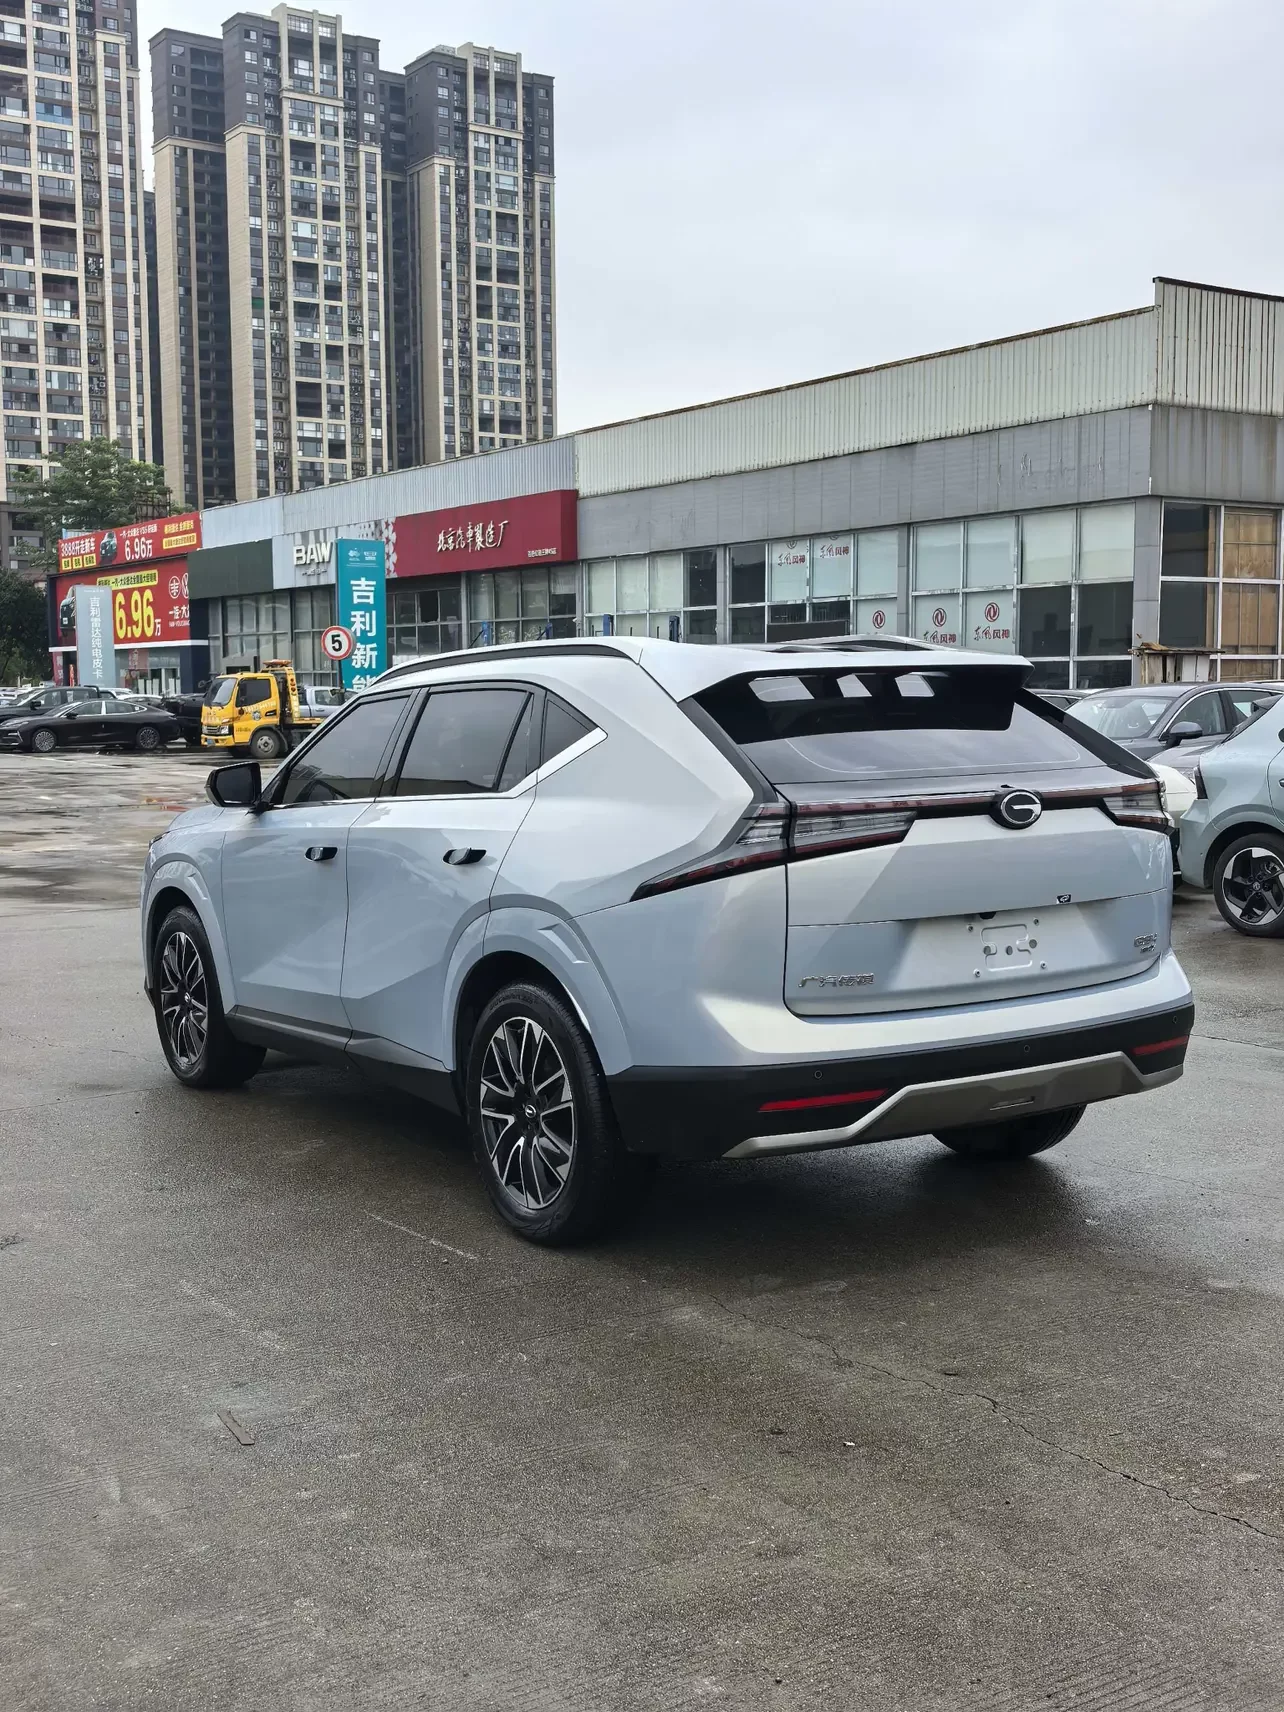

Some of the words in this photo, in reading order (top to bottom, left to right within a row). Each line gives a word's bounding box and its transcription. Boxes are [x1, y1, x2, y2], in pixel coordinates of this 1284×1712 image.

[125, 537, 153, 560] 6.96万
[293, 542, 333, 566] BAW
[115, 589, 161, 639] 6.96万
[89, 596, 103, 680] 吉利雷达纯电皮卡
[331, 633, 342, 652] 5
